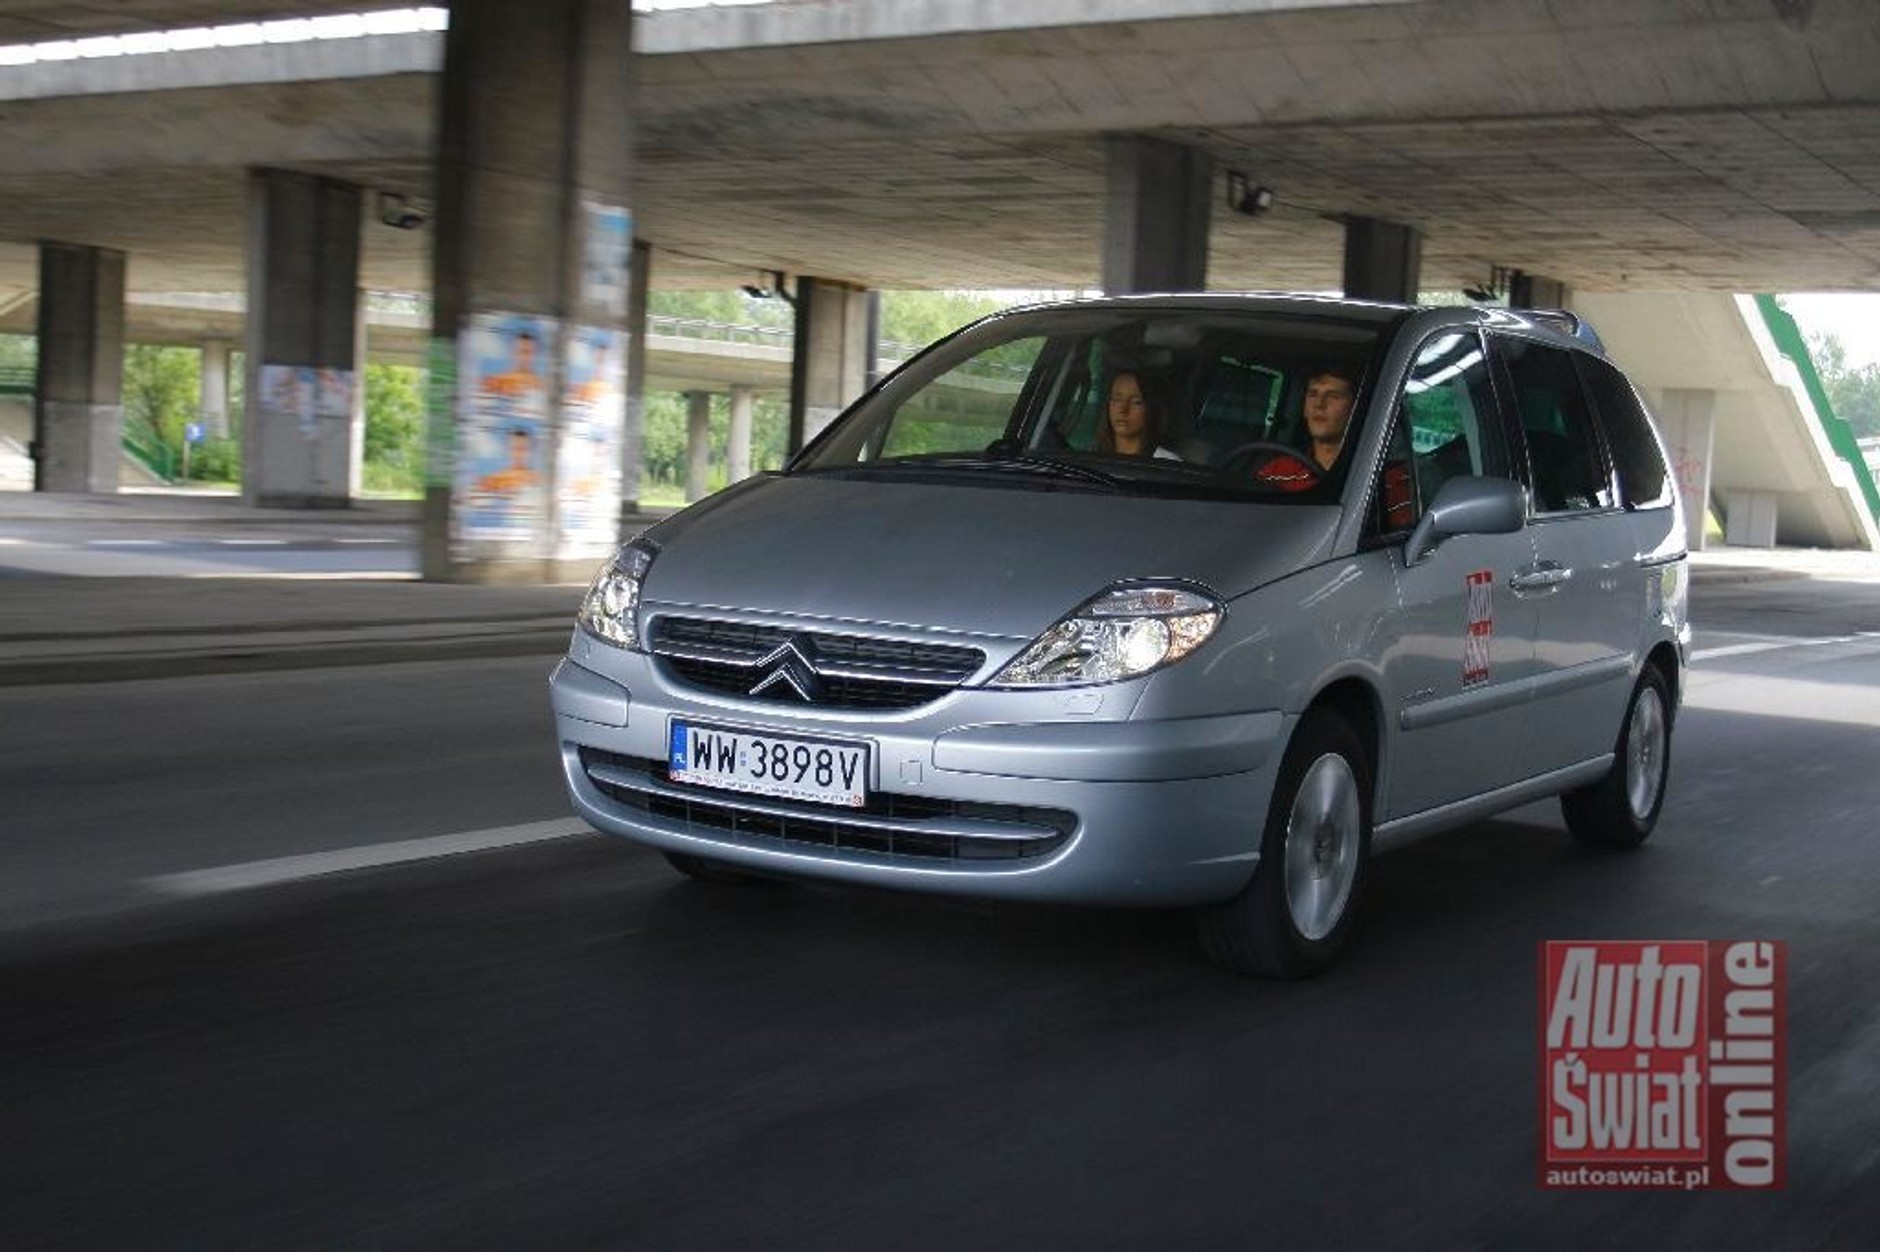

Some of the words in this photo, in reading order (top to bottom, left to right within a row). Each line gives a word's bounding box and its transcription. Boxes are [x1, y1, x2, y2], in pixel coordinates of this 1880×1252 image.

[674, 753, 686, 764] PL
[693, 731, 737, 773] WW
[750, 740, 859, 790] 3898V
